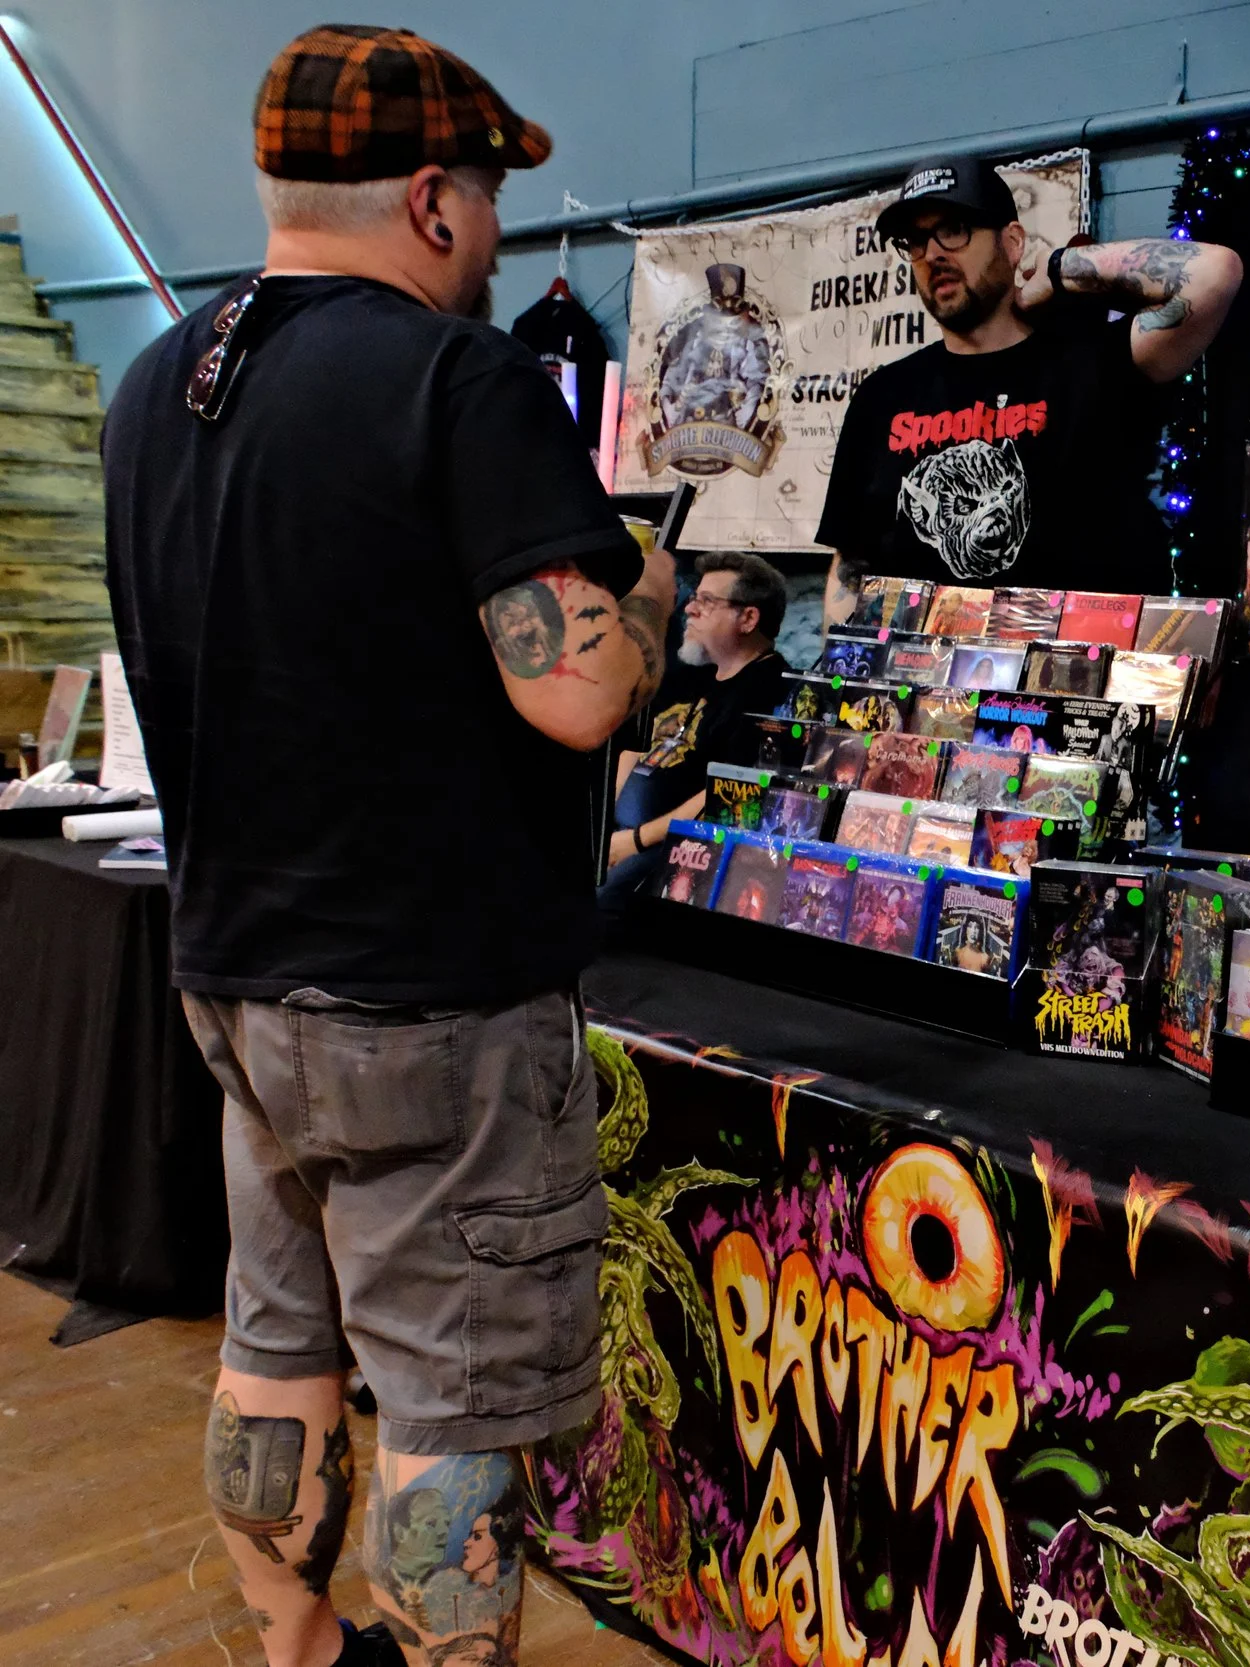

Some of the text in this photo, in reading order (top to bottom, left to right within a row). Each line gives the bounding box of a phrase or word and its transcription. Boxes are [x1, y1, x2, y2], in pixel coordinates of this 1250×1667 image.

[811, 270, 889, 311] EUREKA
[871, 312, 924, 348] WITH
[889, 394, 1047, 457] Spookies
[1085, 702, 1111, 710] EVENING
[713, 778, 761, 805] RATMAN
[669, 846, 711, 870] DOLLS
[1069, 1004, 1131, 1051] TRASH
[1040, 1043, 1124, 1059] VHS MELTDOWN EDITION
[712, 1230, 1017, 1612] BROTHER
